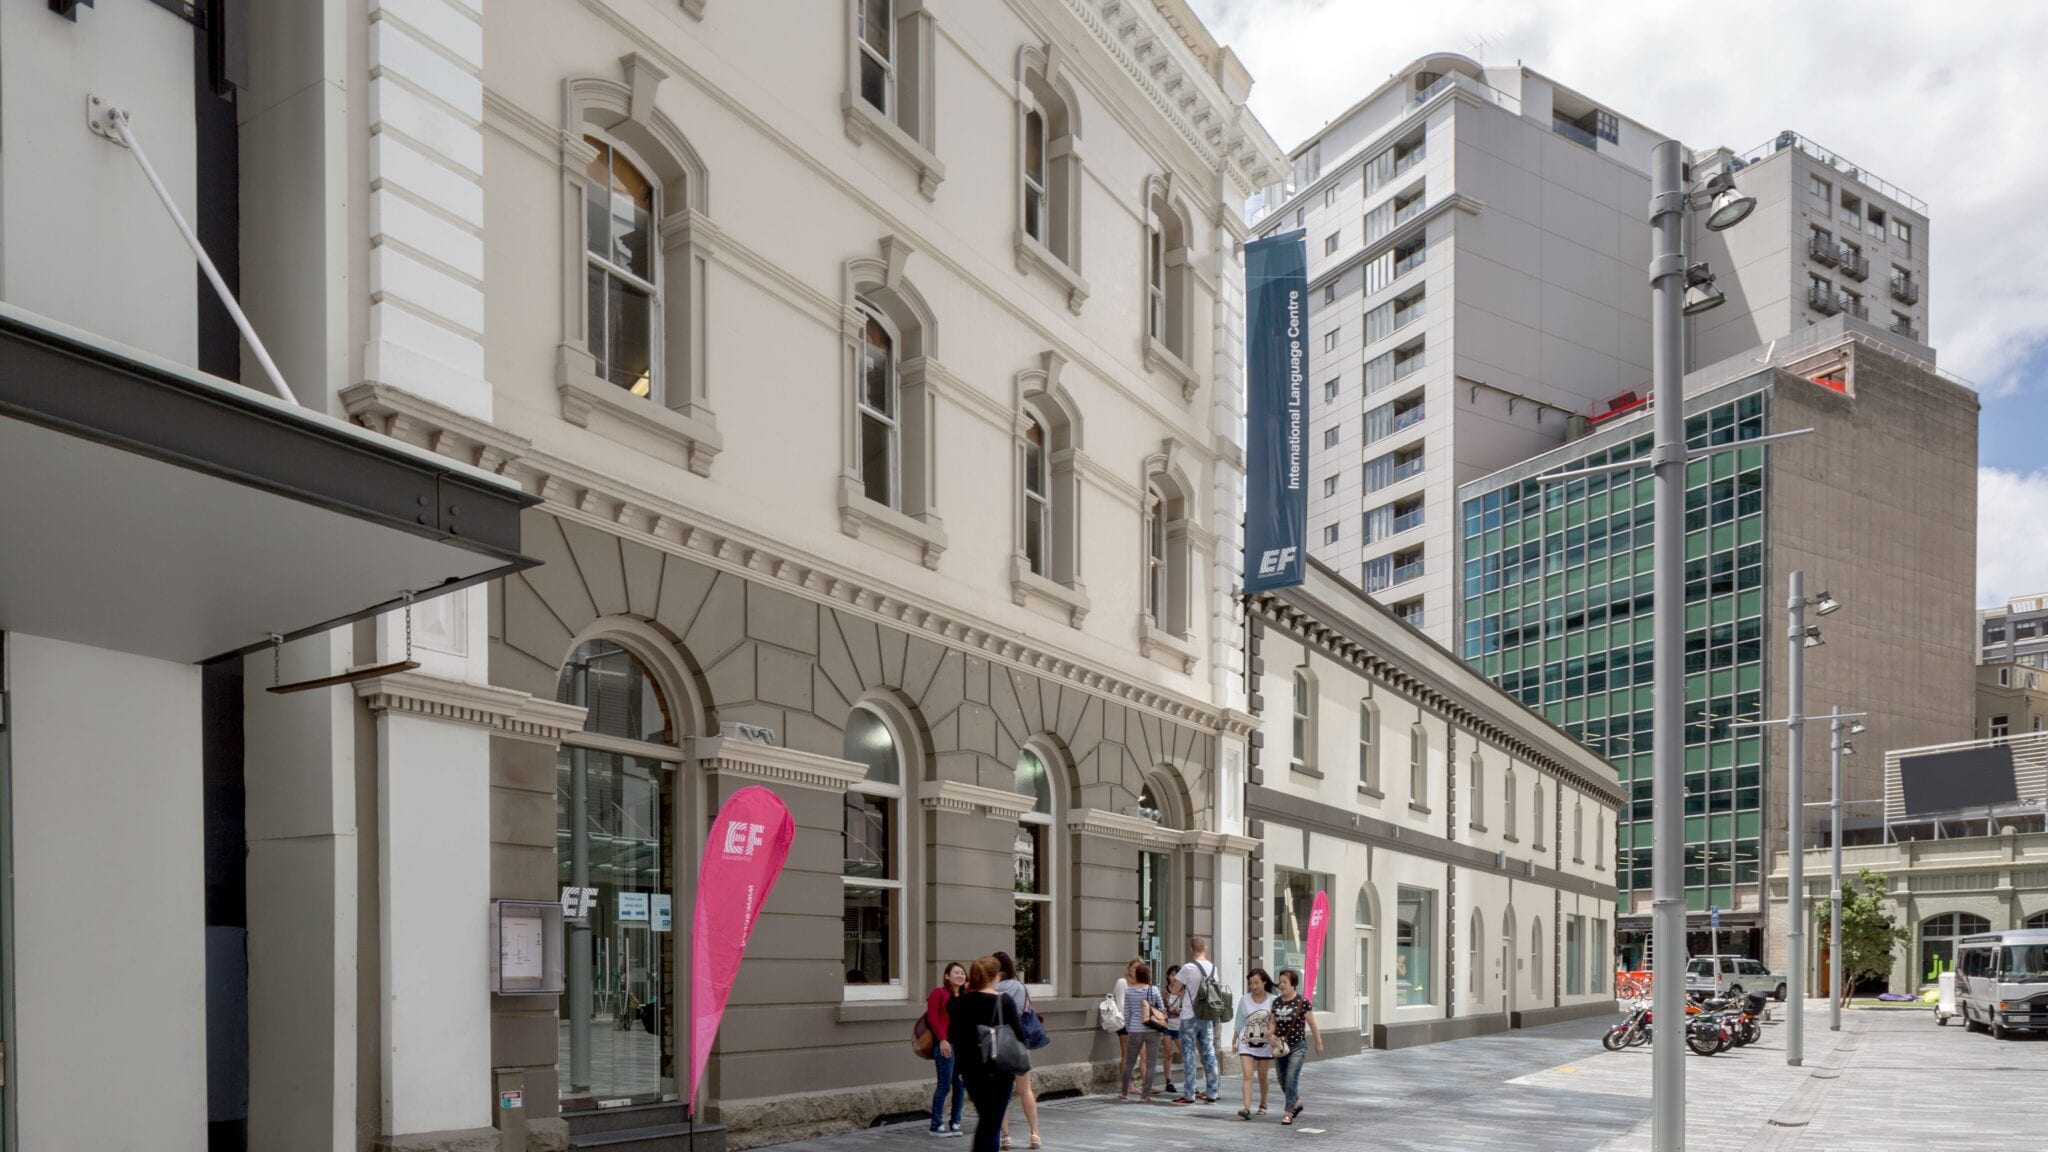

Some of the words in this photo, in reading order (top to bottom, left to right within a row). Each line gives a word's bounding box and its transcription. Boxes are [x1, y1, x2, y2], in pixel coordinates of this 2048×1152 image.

[1287, 290, 1300, 338] Centre
[1288, 340, 1303, 407] Language
[1288, 409, 1300, 490] International
[1258, 546, 1297, 574] EF
[723, 820, 765, 856] EF
[561, 886, 599, 918] EF
[1311, 908, 1324, 927] EF
